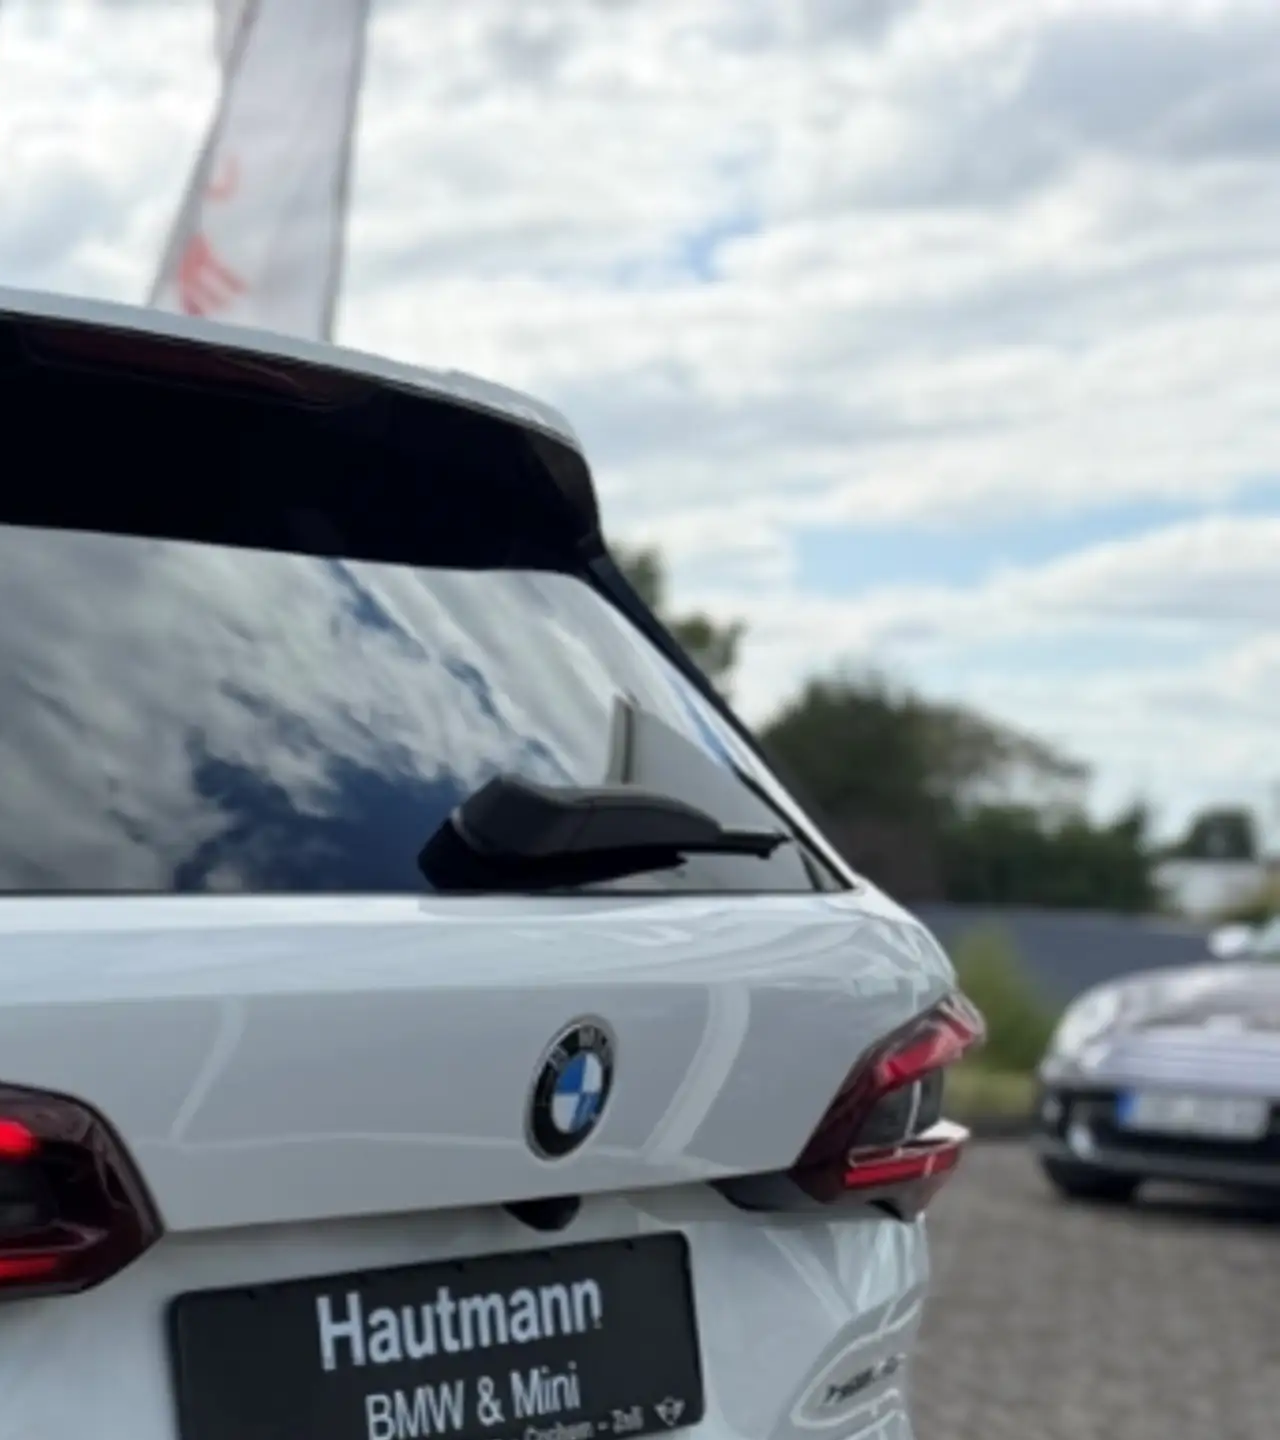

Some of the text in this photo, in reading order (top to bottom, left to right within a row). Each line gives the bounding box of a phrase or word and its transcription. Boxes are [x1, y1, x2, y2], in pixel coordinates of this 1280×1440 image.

[316, 1278, 603, 1371] Hautmann
[476, 1375, 506, 1427] &
[509, 1360, 581, 1419] Mini
